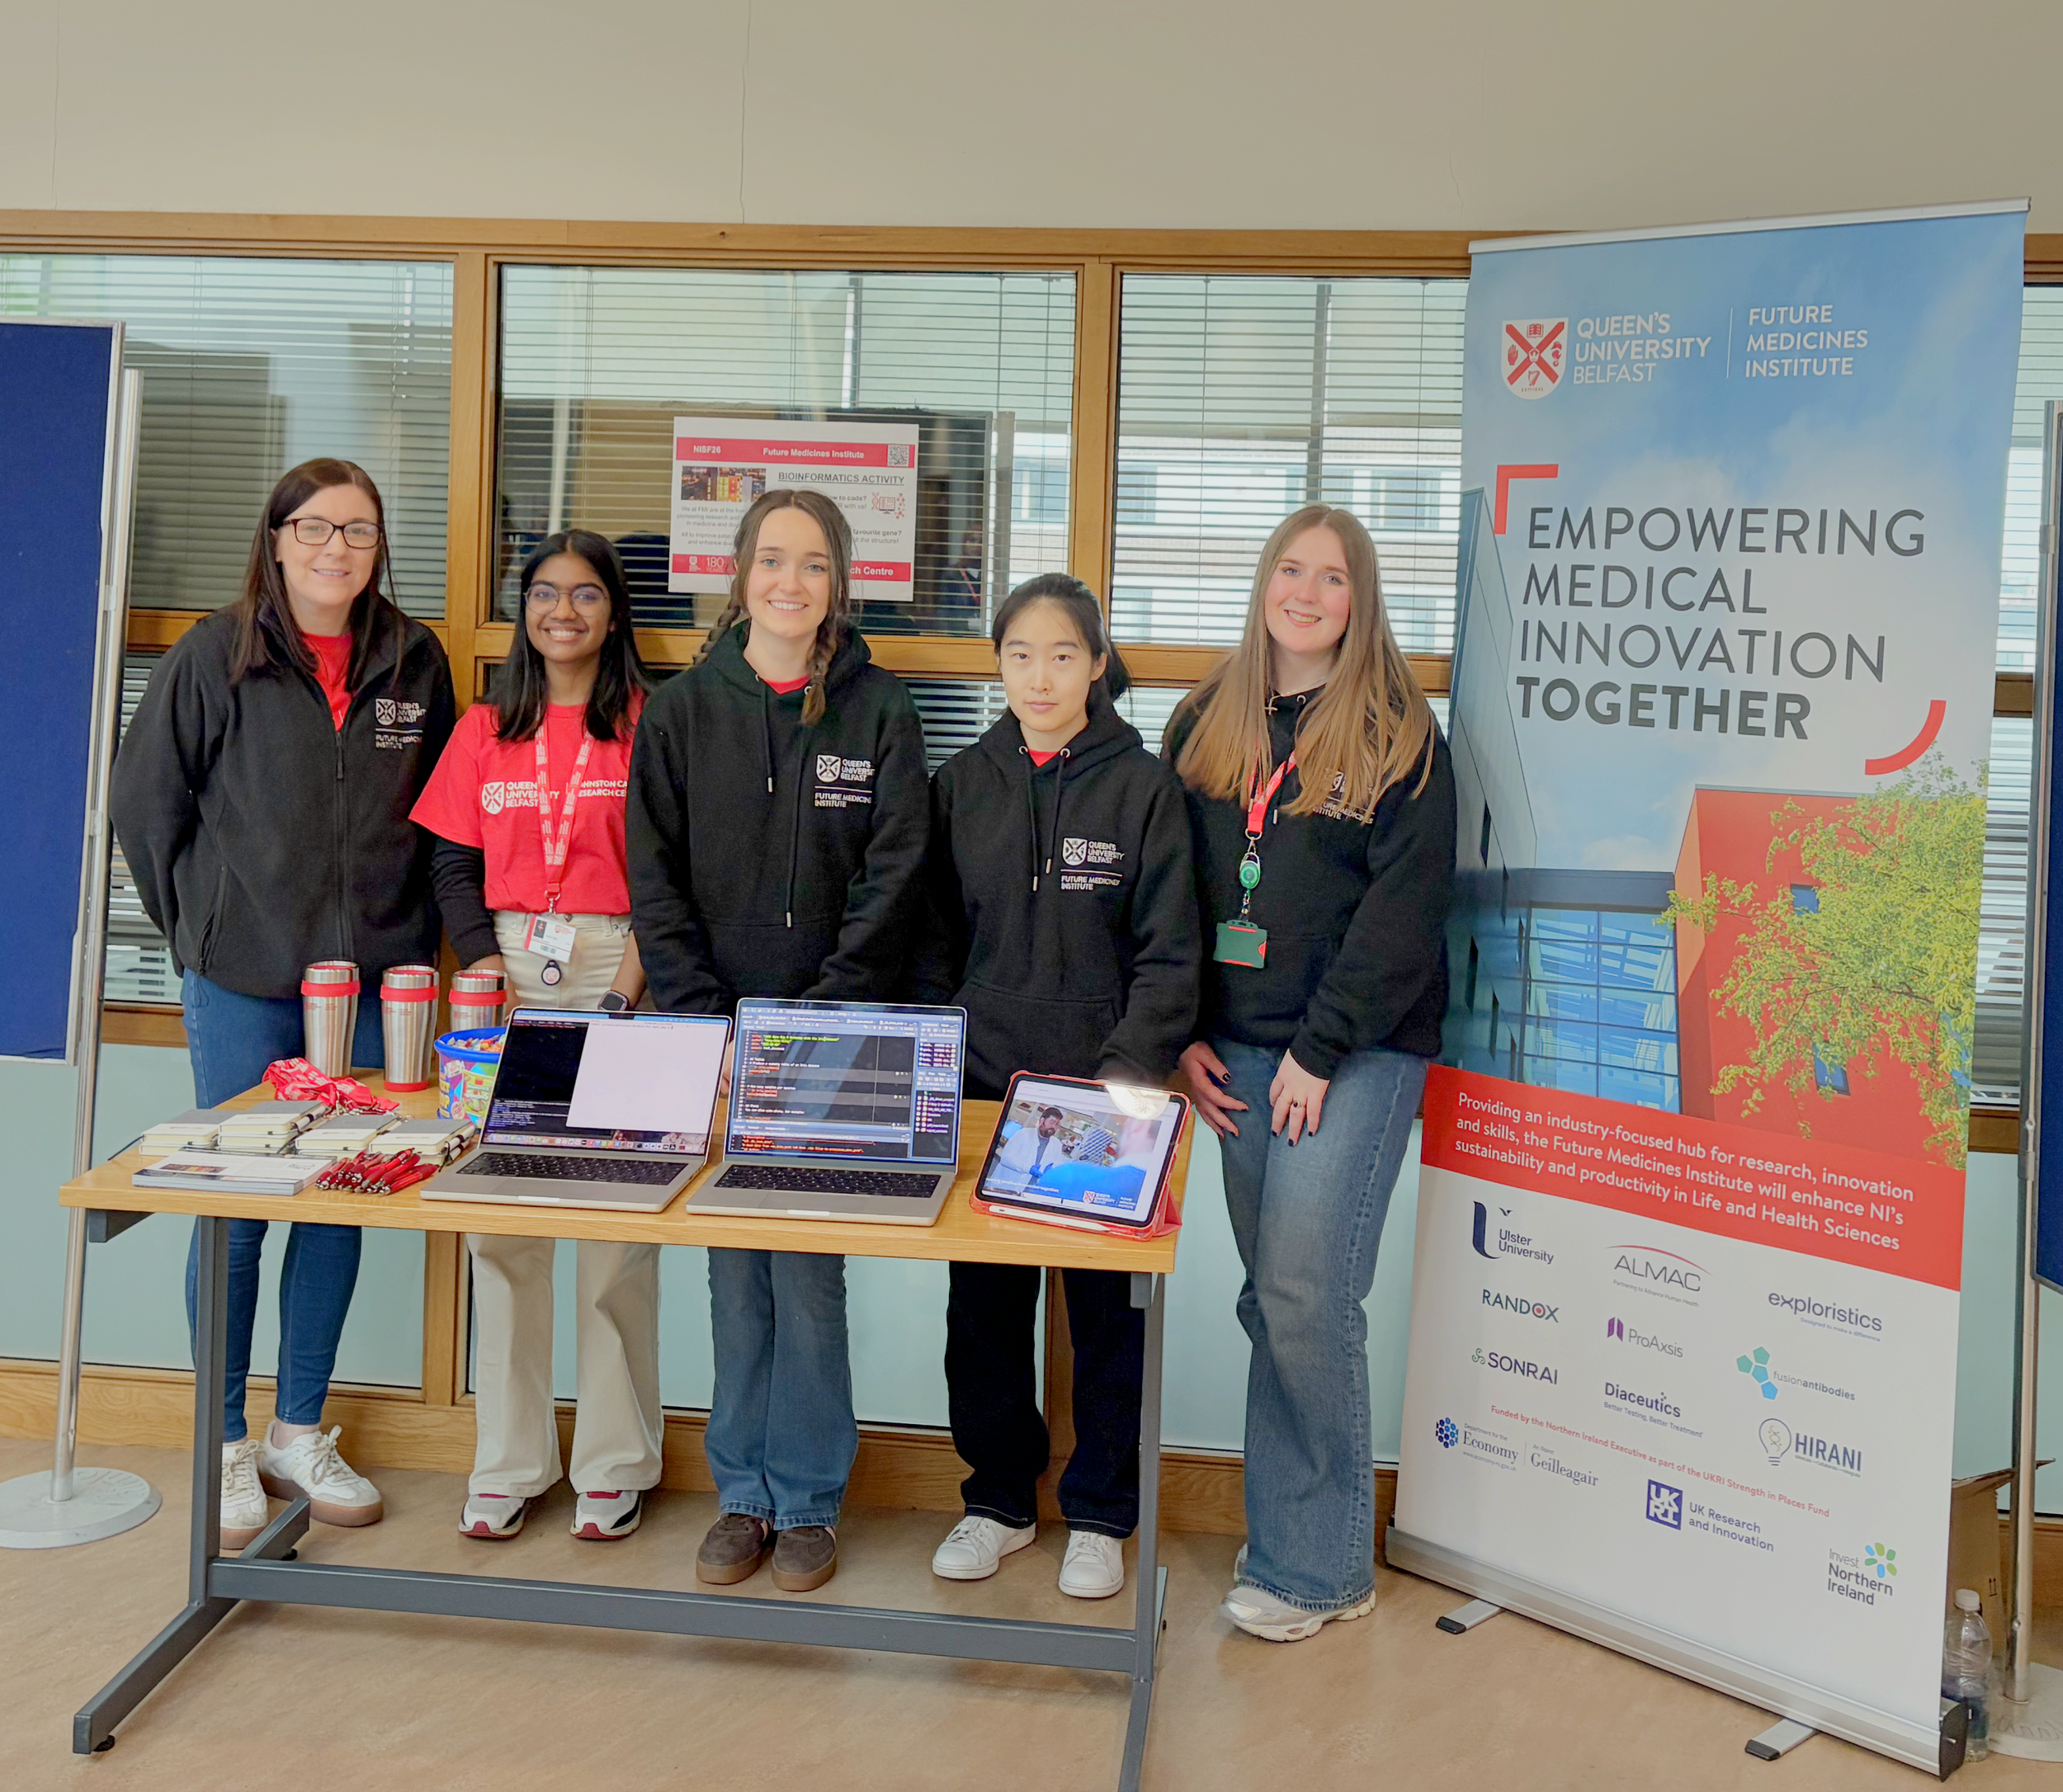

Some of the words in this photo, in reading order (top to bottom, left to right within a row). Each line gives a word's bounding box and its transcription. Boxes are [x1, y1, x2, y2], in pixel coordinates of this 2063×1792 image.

[1577, 312, 1671, 338] QUEEN'S
[1748, 304, 1834, 326] FUTURE
[1574, 336, 1712, 363] UNIVERSITY
[1746, 330, 1869, 351] MEDICINES
[1573, 363, 1657, 384] BELFAST
[1744, 357, 1853, 378] INSTITUTE
[693, 445, 721, 454] NISF26
[762, 447, 789, 457] Future
[790, 448, 830, 459] Medicines
[831, 450, 865, 460] Institute
[778, 472, 859, 483] BIOINFORMATICS
[862, 474, 904, 484] ACTIVITY
[1528, 507, 1924, 556] EMPOWERING
[706, 556, 725, 568] 180
[863, 566, 894, 576] Centre
[1522, 563, 1768, 614] MEDICAL
[1520, 620, 1885, 683] INNOVATION
[1516, 677, 1811, 739] TOGETHER
[506, 781, 538, 790] QUEEN
[814, 792, 843, 800] FUTURE
[506, 799, 539, 808] BELFAST
[1459, 1092, 1521, 1123] Providing
[1525, 1111, 1542, 1125] an
[1547, 1111, 1673, 1151] industry-focused
[1678, 1139, 1706, 1158] hub
[1711, 1146, 1735, 1164] for
[1739, 1156, 1817, 1185] research,
[1822, 1167, 1914, 1201] innovation
[1456, 1116, 1480, 1133] and
[1484, 1122, 1520, 1145] skills,
[1524, 1130, 1549, 1148] the
[1553, 1135, 1603, 1159] Future
[1607, 1147, 1682, 1177] Medicines
[1686, 1164, 1754, 1193] Institute
[1758, 1182, 1787, 1200] will
[1792, 1191, 1864, 1216] enhance
[1870, 1202, 1904, 1225] NI's
[1455, 1139, 1545, 1174] sustainability
[1548, 1162, 1576, 1177] and
[1579, 1167, 1670, 1203] productivity
[1674, 1186, 1688, 1203] in
[1692, 1190, 1722, 1211] Life
[1725, 1203, 1756, 1219] and
[1762, 1205, 1819, 1231] Health
[1824, 1219, 1900, 1250] Sciences
[1499, 1228, 1532, 1246] Ulster
[1499, 1239, 1554, 1264] University
[1614, 1255, 1701, 1292] ALMAC
[1482, 1289, 1560, 1323] RANDOX
[1768, 1292, 1882, 1332] exploristics
[1628, 1328, 1683, 1358] ProAxsis
[1487, 1351, 1558, 1385] SONRAI
[1605, 1382, 1681, 1417] Diaceutics
[1773, 1370, 1856, 1401] fusionantibodies
[1604, 1402, 1622, 1413] Better
[1463, 1430, 1519, 1464] Economy
[1491, 1405, 1518, 1420] Funded
[1520, 1413, 1530, 1424] by
[1532, 1417, 1544, 1427] the
[1546, 1422, 1580, 1438] Northern
[1582, 1432, 1608, 1447] Ireland
[1610, 1441, 1647, 1460] Executive
[1658, 1458, 1675, 1470] part
[1676, 1464, 1686, 1473] of
[1688, 1467, 1701, 1478] the
[1703, 1472, 1725, 1486] UKRI
[1727, 1479, 1766, 1498] Strength
[1768, 1490, 1776, 1500] in
[1778, 1493, 1806, 1510] Places
[1808, 1502, 1829, 1517] Fund
[1795, 1432, 1862, 1473] HIRANI
[1531, 1452, 1599, 1486] Geilleagair
[1689, 1502, 1706, 1516] UK
[1708, 1508, 1761, 1534] Research
[1688, 1516, 1709, 1531] and
[1712, 1524, 1774, 1552] Innovation
[1829, 1548, 1859, 1568] Invest
[1828, 1577, 1874, 1606] Ireland
[1829, 1562, 1893, 1596] Northern
